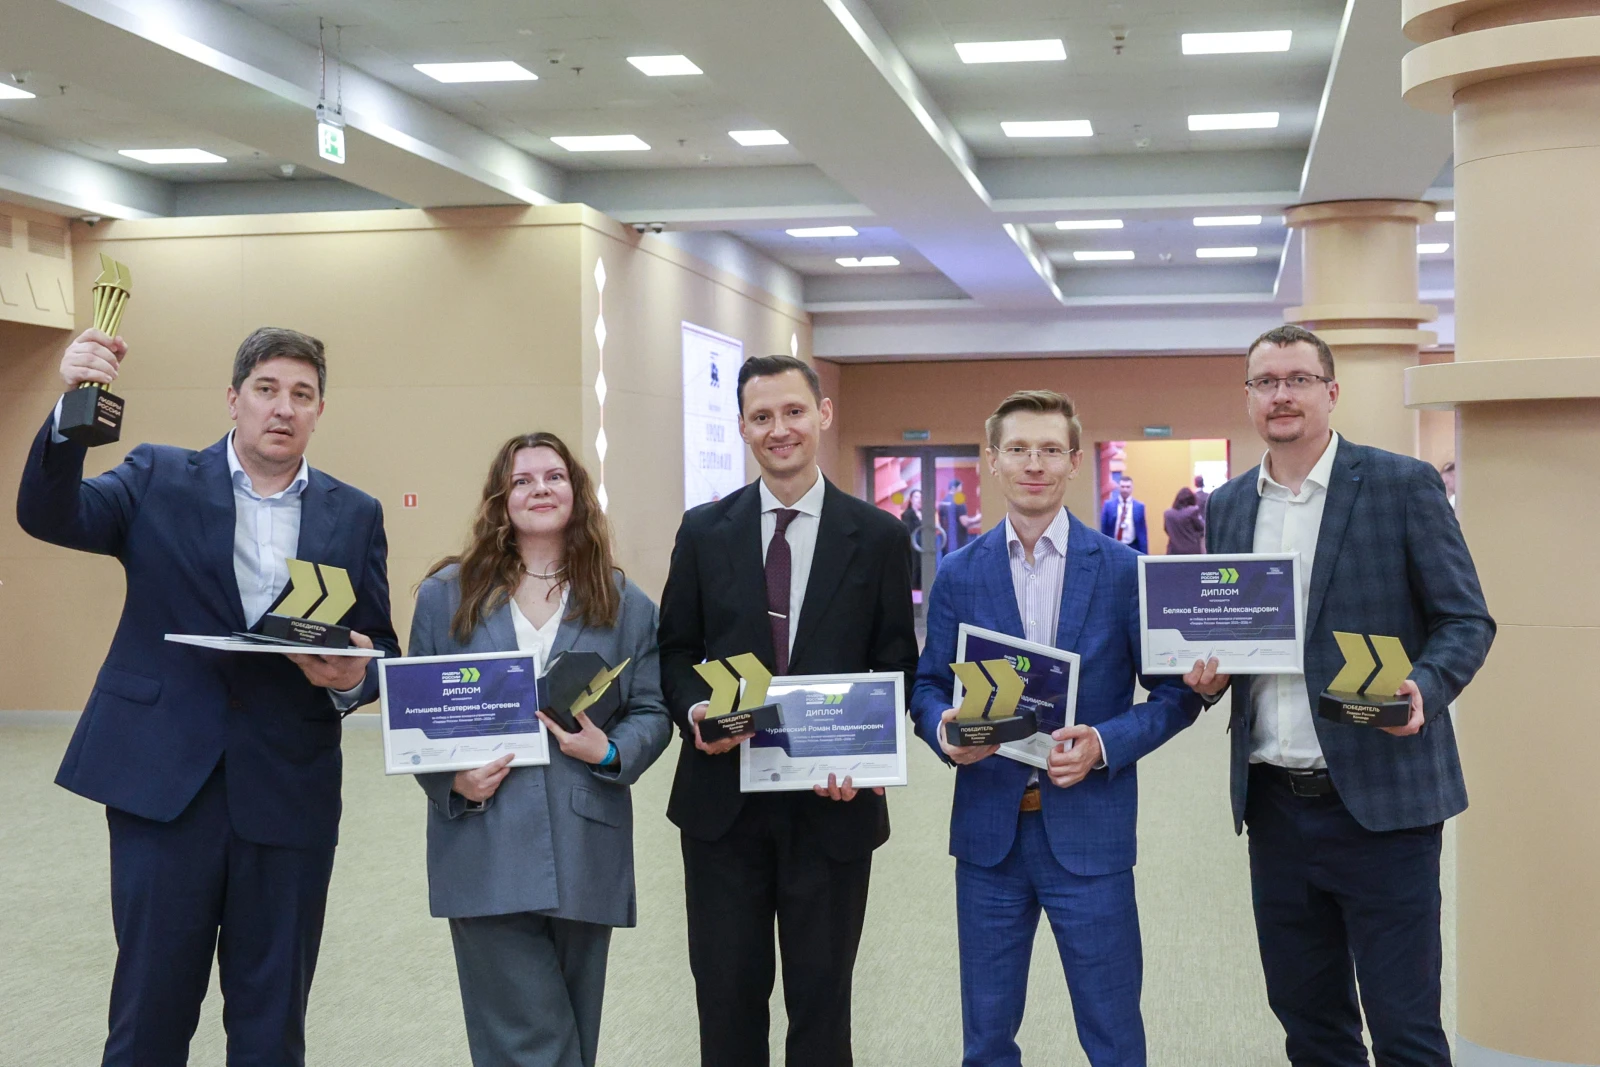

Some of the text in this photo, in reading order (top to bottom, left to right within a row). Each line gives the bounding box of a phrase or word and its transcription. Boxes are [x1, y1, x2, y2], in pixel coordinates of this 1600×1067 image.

[98, 396, 122, 410] ЛИДЕРЫ
[98, 402, 120, 416] РОССИИ
[1200, 588, 1239, 597] ДИПЛОМ
[291, 621, 327, 632] ПОБЕДИТЕЛЬ
[442, 687, 481, 696] ДИПЛОМ
[482, 702, 520, 710] Сергеевна
[1343, 704, 1380, 712] ПОБЕДИТЕЛЬ
[806, 708, 843, 717] ДИПЛОМ
[718, 714, 751, 724] ПОБЕДИТЕЛЬ
